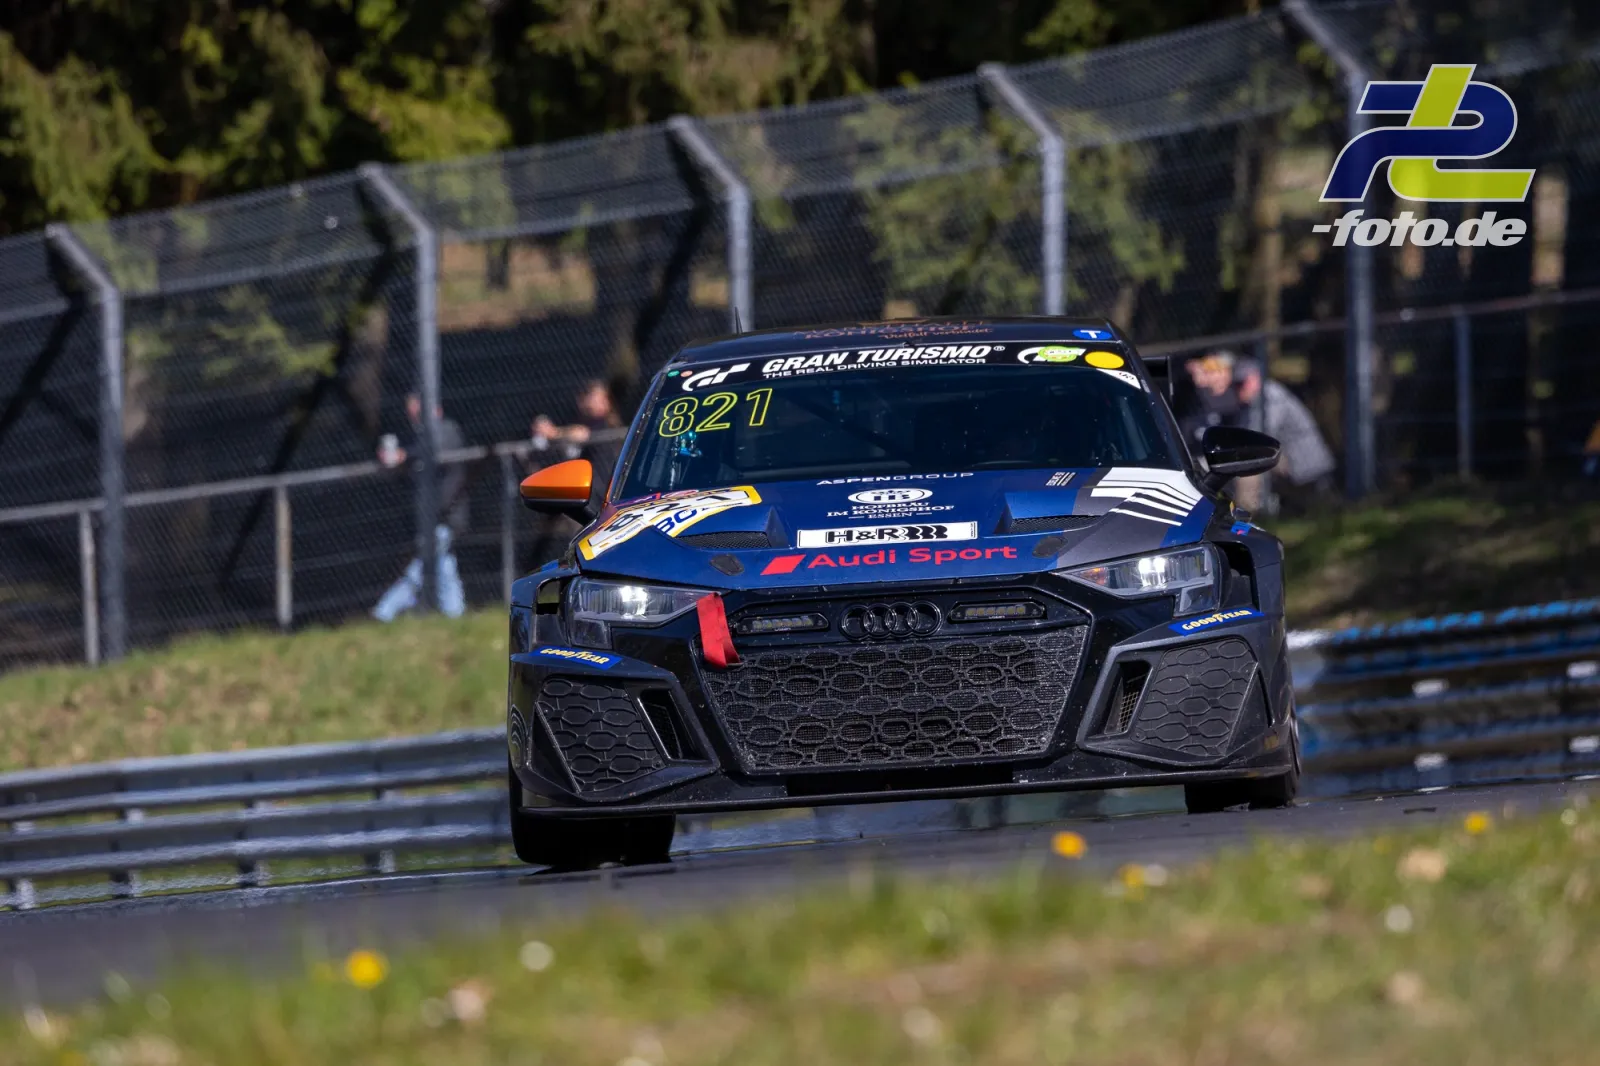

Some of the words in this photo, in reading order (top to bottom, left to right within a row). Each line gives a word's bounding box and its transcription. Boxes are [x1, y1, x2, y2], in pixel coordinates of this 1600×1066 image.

[761, 351, 849, 374] GRAN
[763, 371, 792, 379] THE
[793, 367, 834, 377] REAL
[836, 361, 898, 372] DRIVING
[900, 357, 986, 366] SIMULATOR
[658, 387, 773, 438] 821
[816, 472, 974, 486] ASPENGROUP
[826, 510, 849, 518] IM
[807, 549, 896, 569] Audi
[908, 546, 1017, 565] Sport
[1182, 610, 1252, 631] GOODYEAR
[539, 648, 610, 664] GOODYEAR
